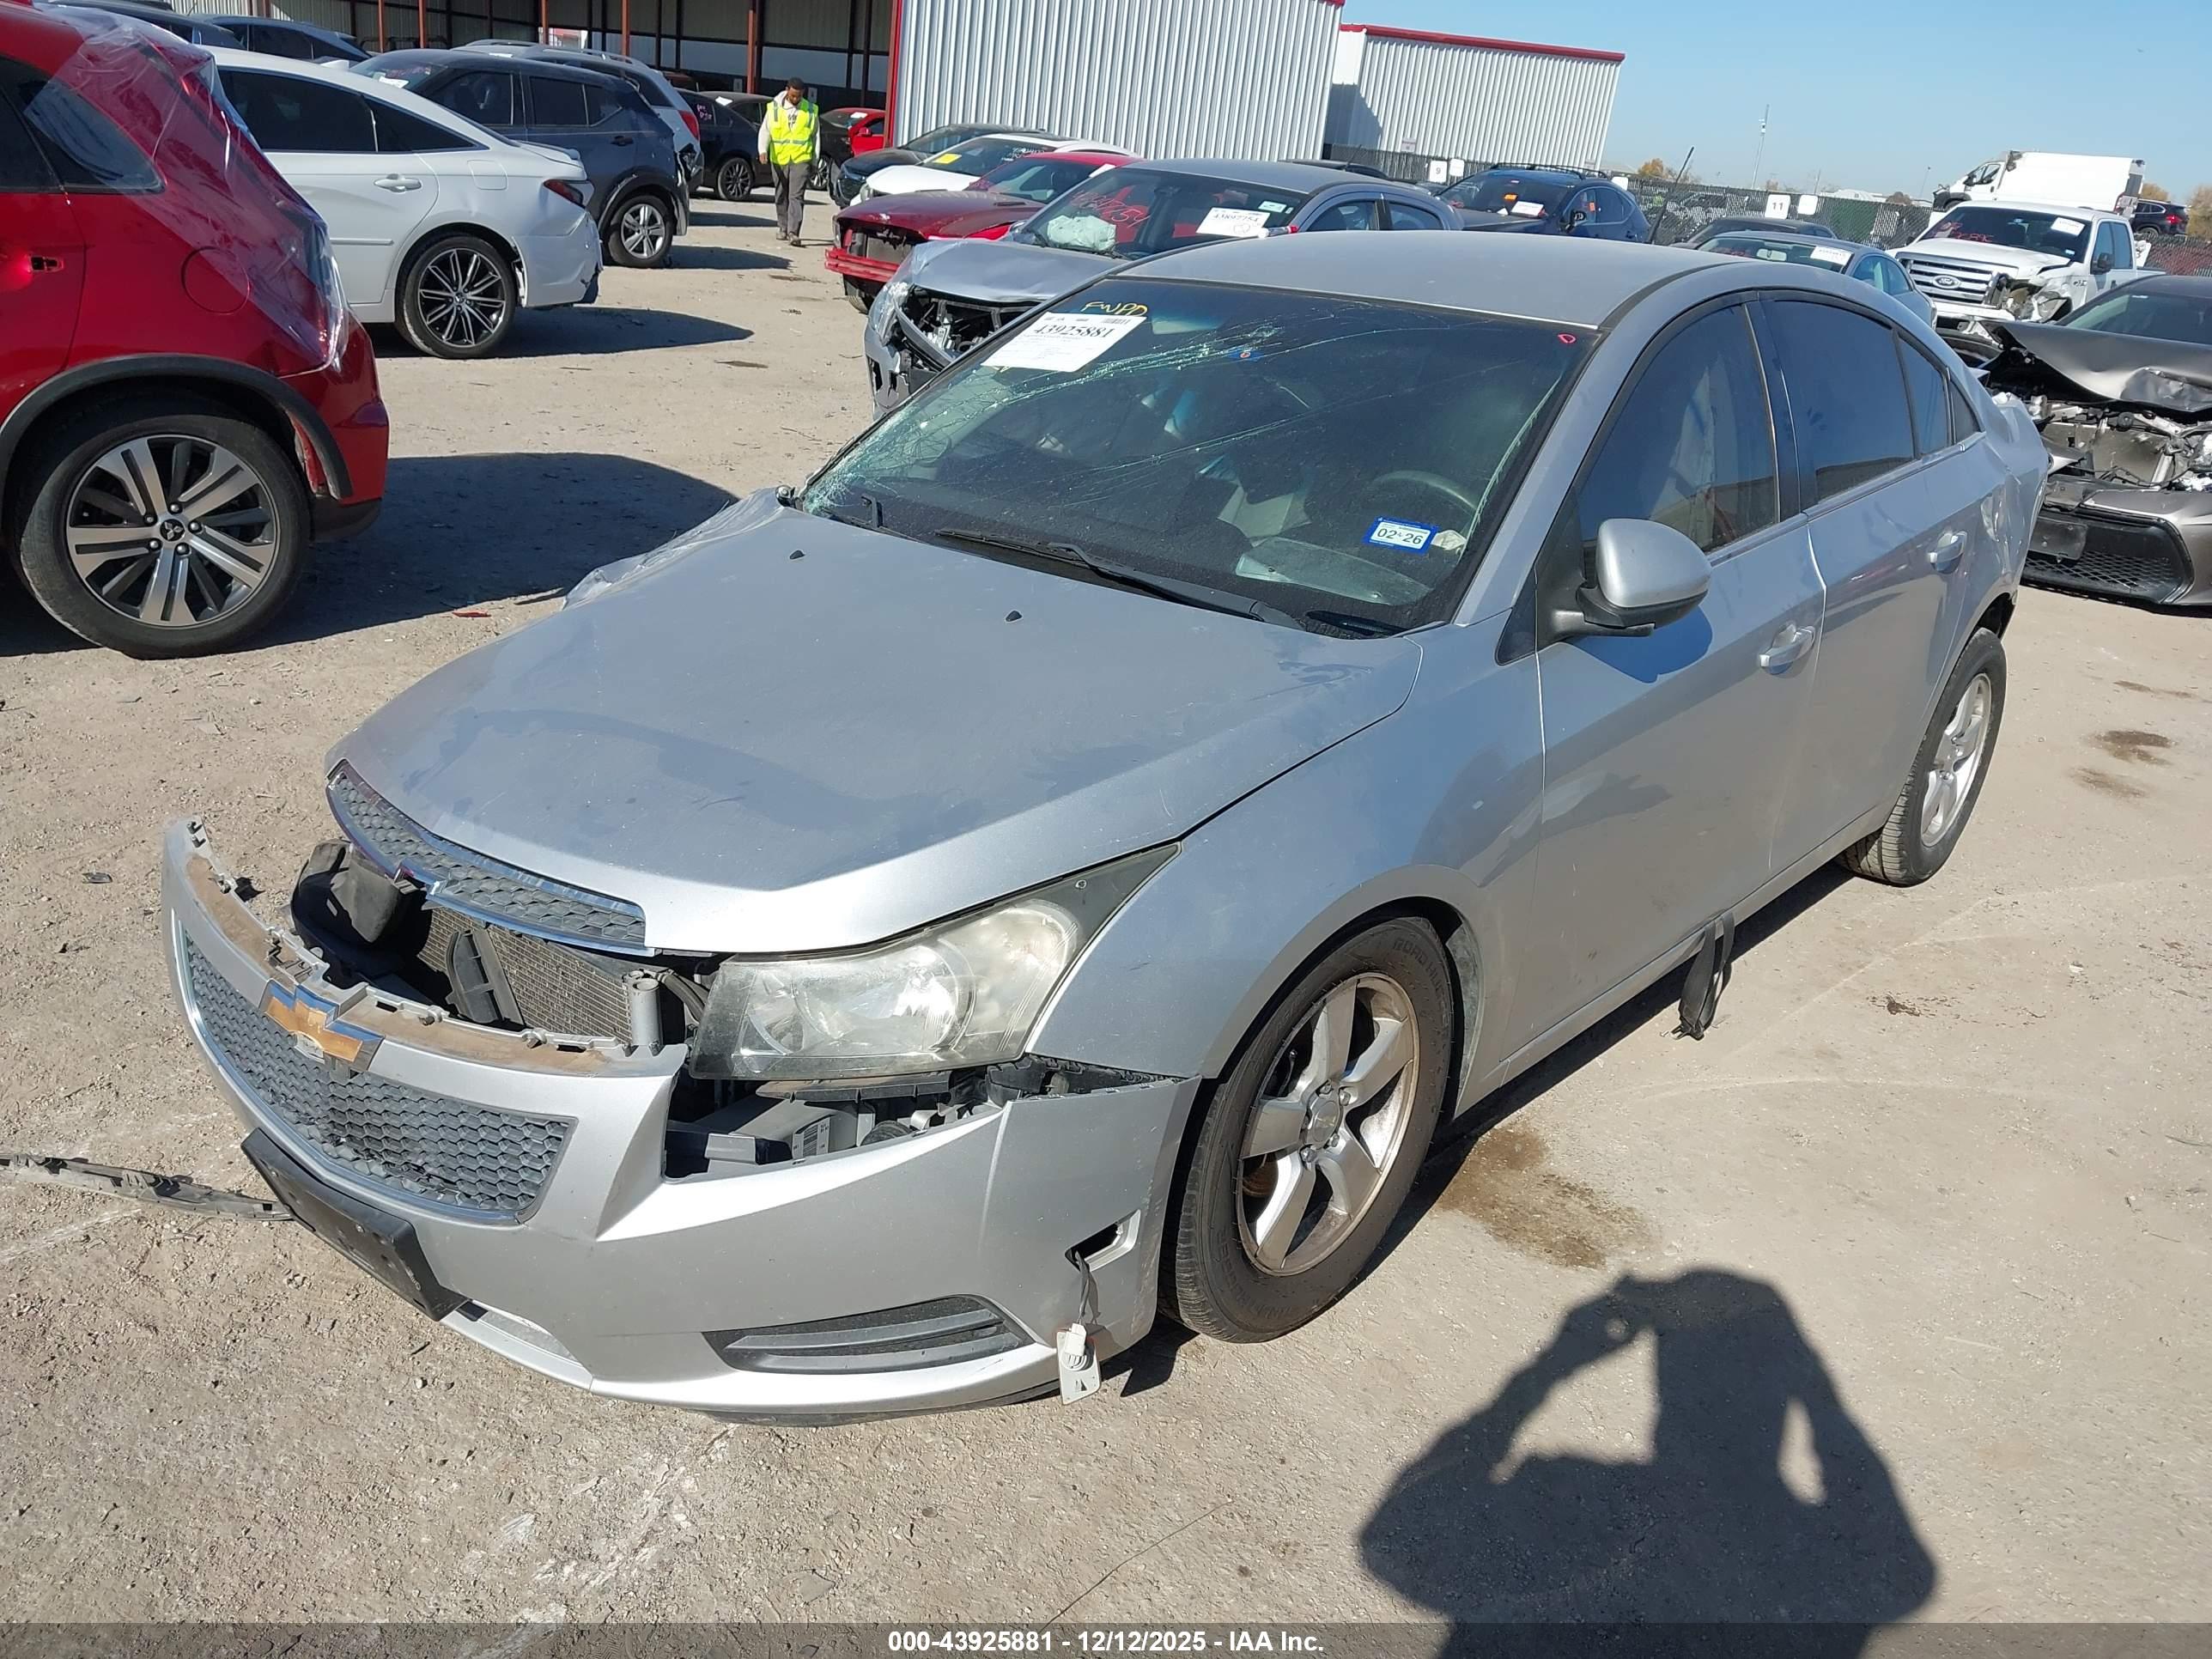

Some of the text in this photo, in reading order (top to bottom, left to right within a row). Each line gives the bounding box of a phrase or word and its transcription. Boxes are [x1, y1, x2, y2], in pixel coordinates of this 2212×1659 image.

[1771, 202, 1784, 211] 11
[1032, 324, 1116, 338] 43925881
[1377, 528, 1397, 539] 02
[1402, 532, 1424, 544] 26
